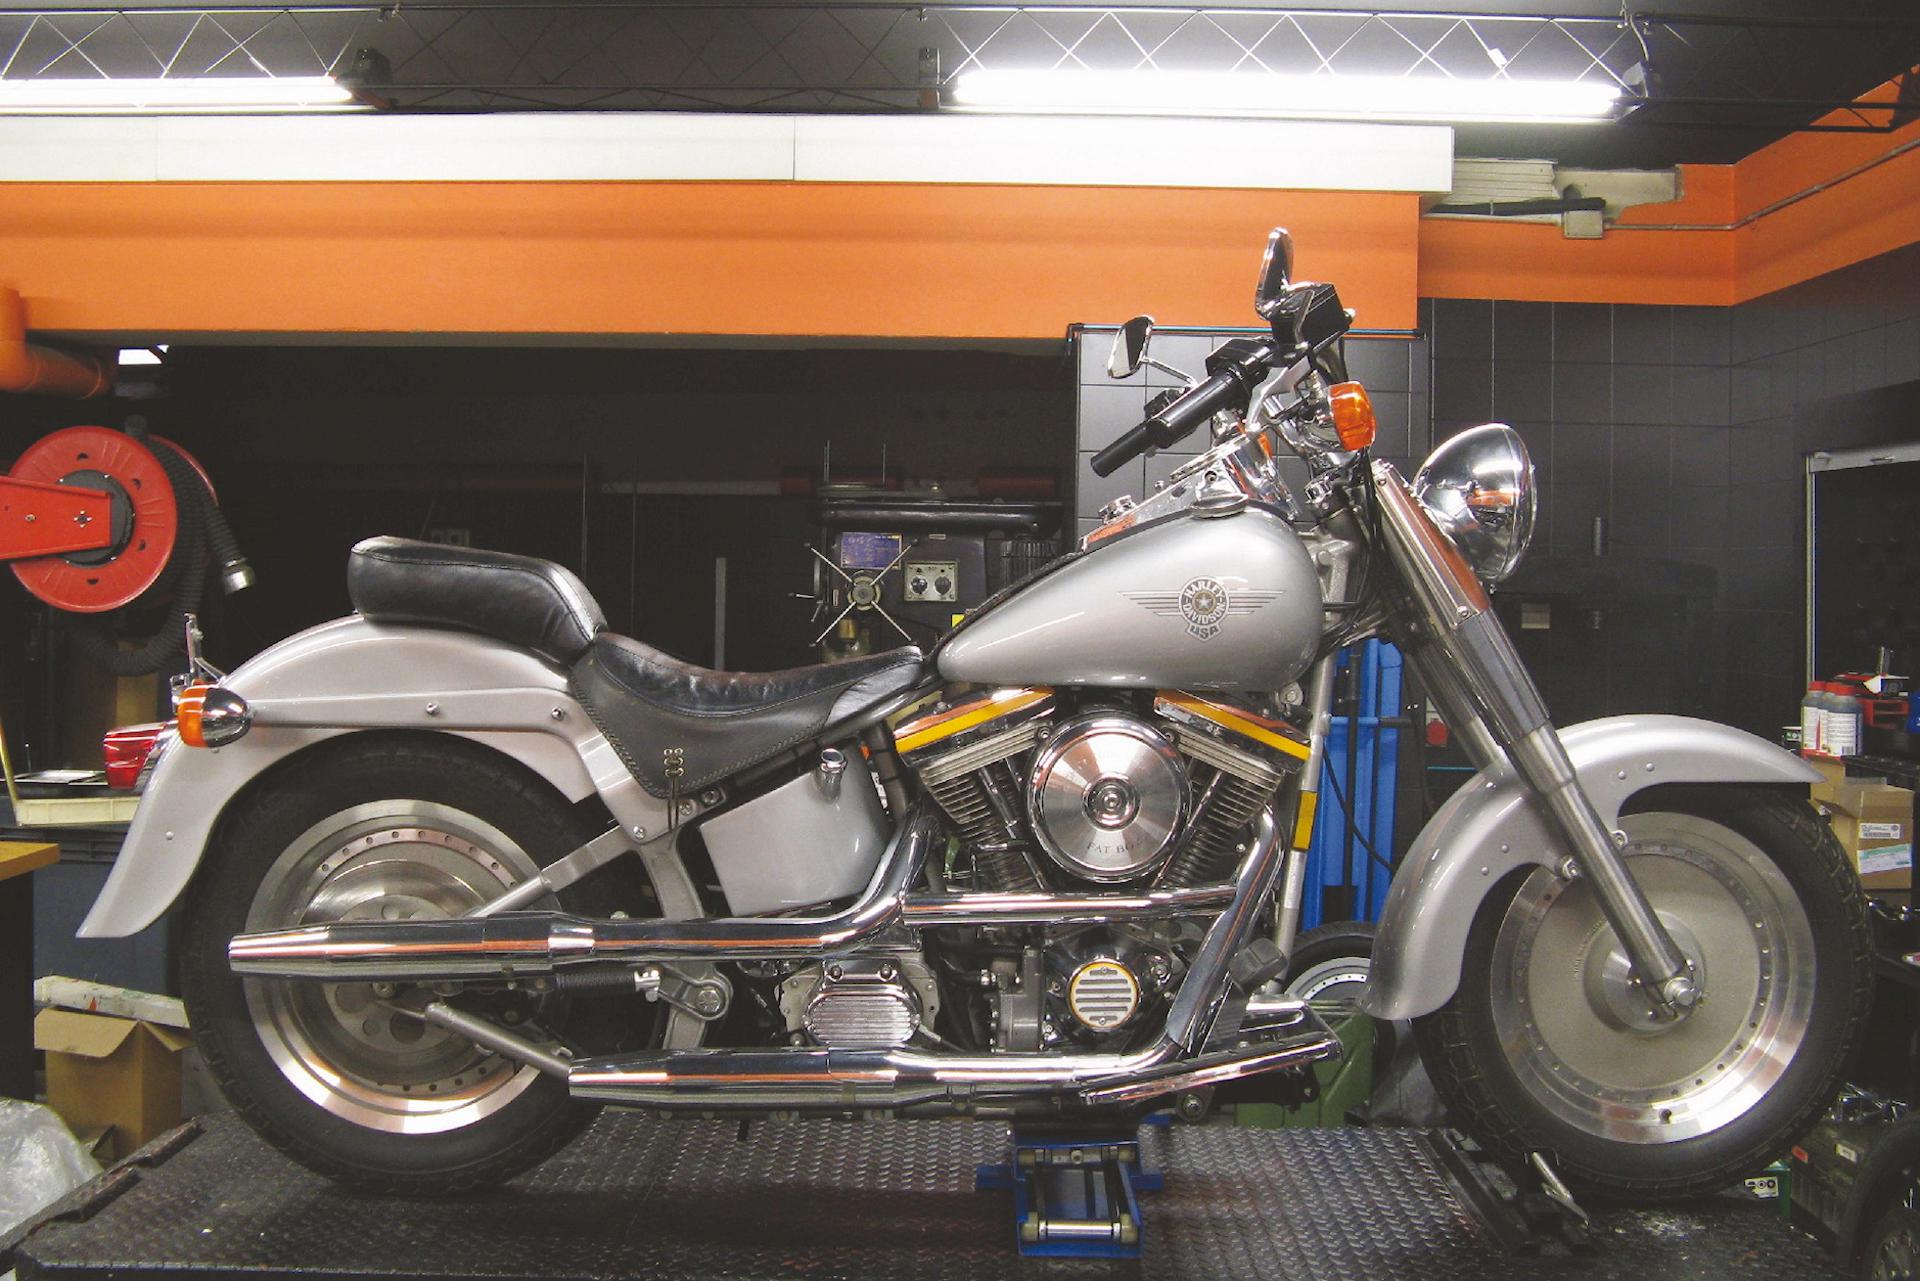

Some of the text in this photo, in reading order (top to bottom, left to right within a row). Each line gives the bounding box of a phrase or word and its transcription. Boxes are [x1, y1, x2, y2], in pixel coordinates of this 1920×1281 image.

[1184, 580, 1225, 599] HARLEY
[1182, 602, 1226, 624] DAVIDSON
[1190, 625, 1218, 639] USA
[1086, 840, 1112, 854] FAT
